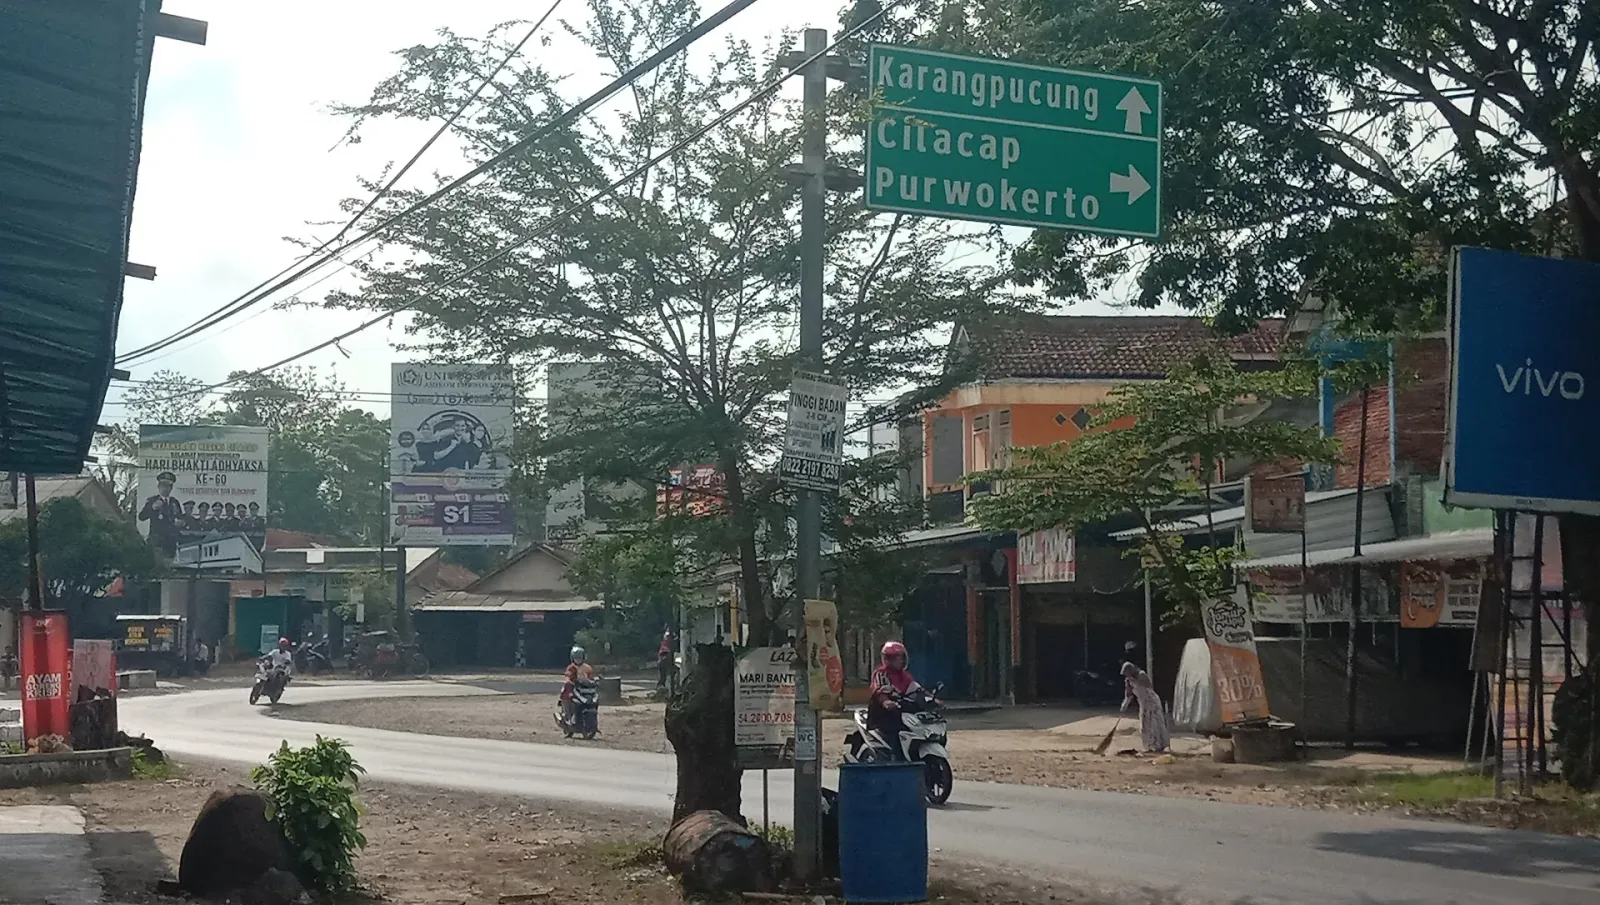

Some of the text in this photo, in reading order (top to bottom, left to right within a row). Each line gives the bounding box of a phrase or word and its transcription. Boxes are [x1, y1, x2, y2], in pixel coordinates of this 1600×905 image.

[879, 55, 1098, 121] Karangpucung
[877, 118, 1020, 168] Cilacap
[875, 166, 1100, 221] Purwokerto
[1496, 357, 1585, 400] vivo
[790, 392, 846, 415] TINGGI BADAN
[145, 459, 263, 472] HARI BHAKTI ADHYAKSA
[782, 456, 801, 474] 0822
[802, 460, 820, 477] 2197
[443, 505, 470, 524] S1
[27, 673, 61, 684] AYAM
[739, 673, 796, 683] MARI BANT
[1218, 675, 1262, 702] 30%
[26, 689, 61, 698] KRISPI
[798, 734, 814, 742] WC
